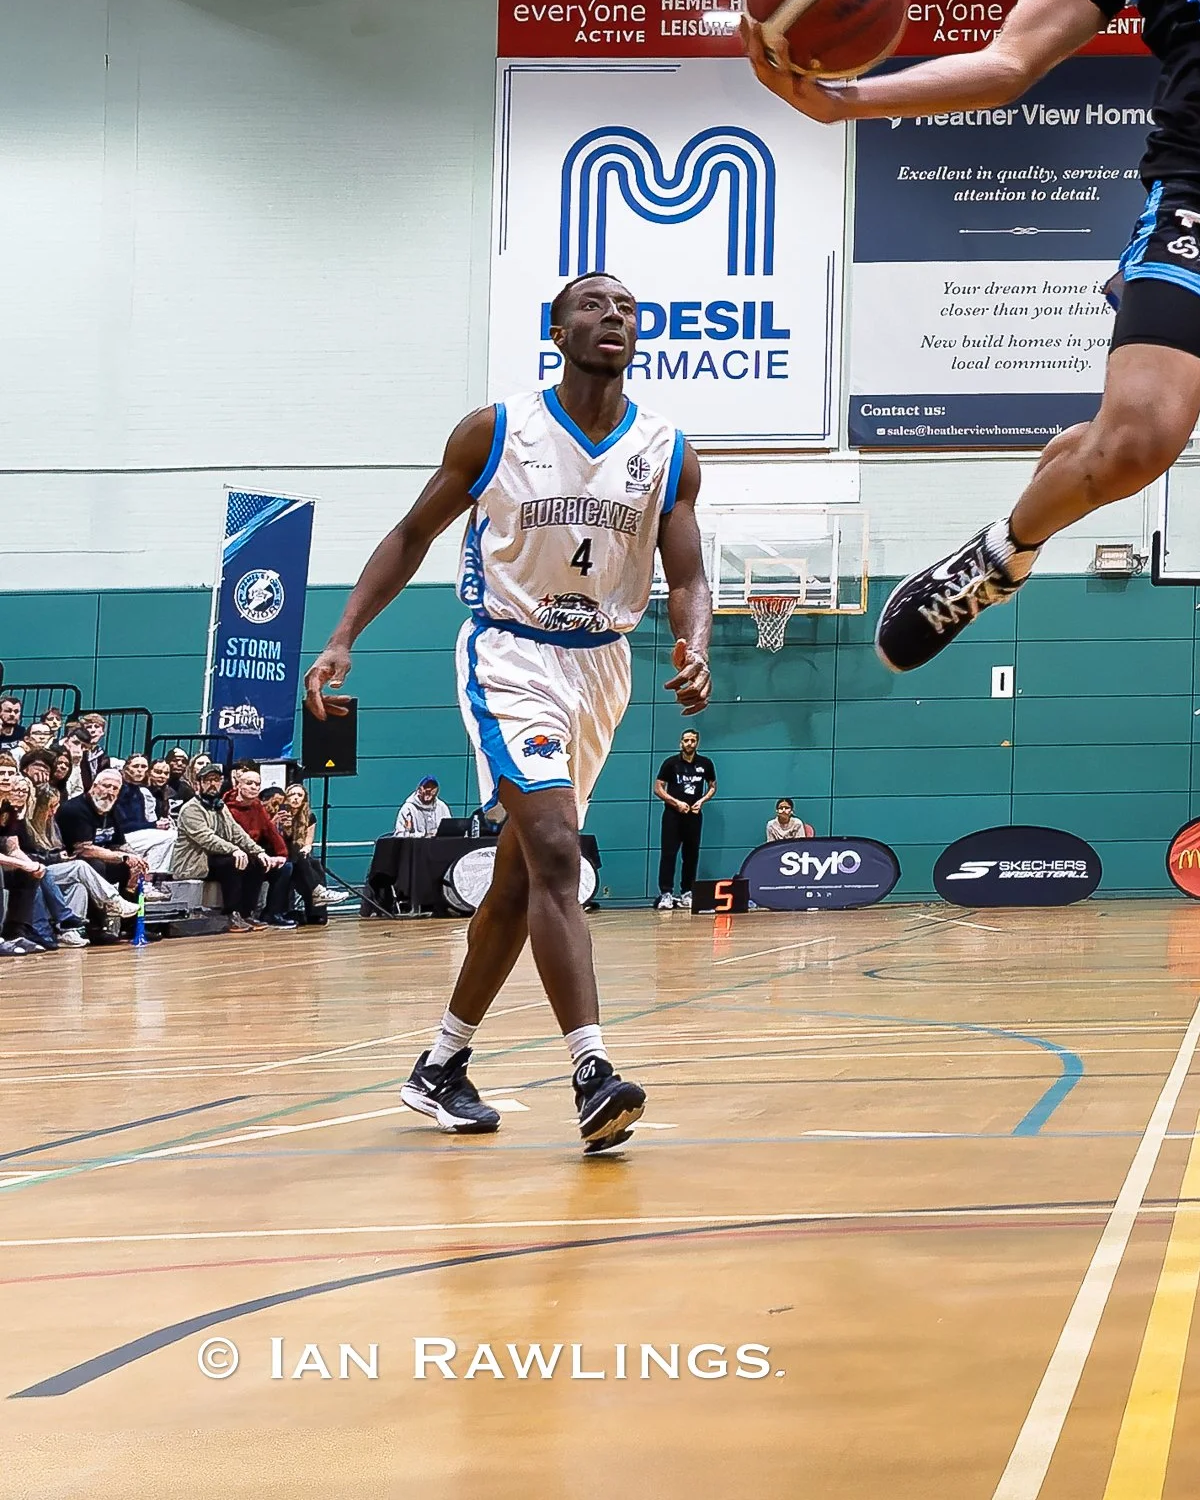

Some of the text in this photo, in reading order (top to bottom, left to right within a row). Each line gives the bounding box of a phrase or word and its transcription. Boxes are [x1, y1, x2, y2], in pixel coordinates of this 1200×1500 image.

[575, 30, 646, 43] ACTIVE
[1021, 103, 1080, 125] View
[1086, 103, 1157, 125] Hom
[897, 166, 1142, 184] Excellent in quality, service an
[953, 186, 1100, 201] attention to detail.
[943, 281, 1105, 295] Your dream home is
[940, 303, 1112, 319] closer than you think
[540, 301, 791, 340] DESIL
[920, 333, 1112, 351] New build homes in yo
[538, 350, 789, 380] PRMACIE
[951, 356, 1092, 373] local community.
[860, 403, 946, 416] Contact us:
[887, 424, 1063, 436] sales@heatherviewhomes.co.uk
[520, 496, 642, 536] HURRICANES
[570, 538, 593, 577] 4
[226, 637, 281, 660] STORM
[218, 658, 286, 681] JUNIORS
[998, 860, 1087, 871] SKECHERS
